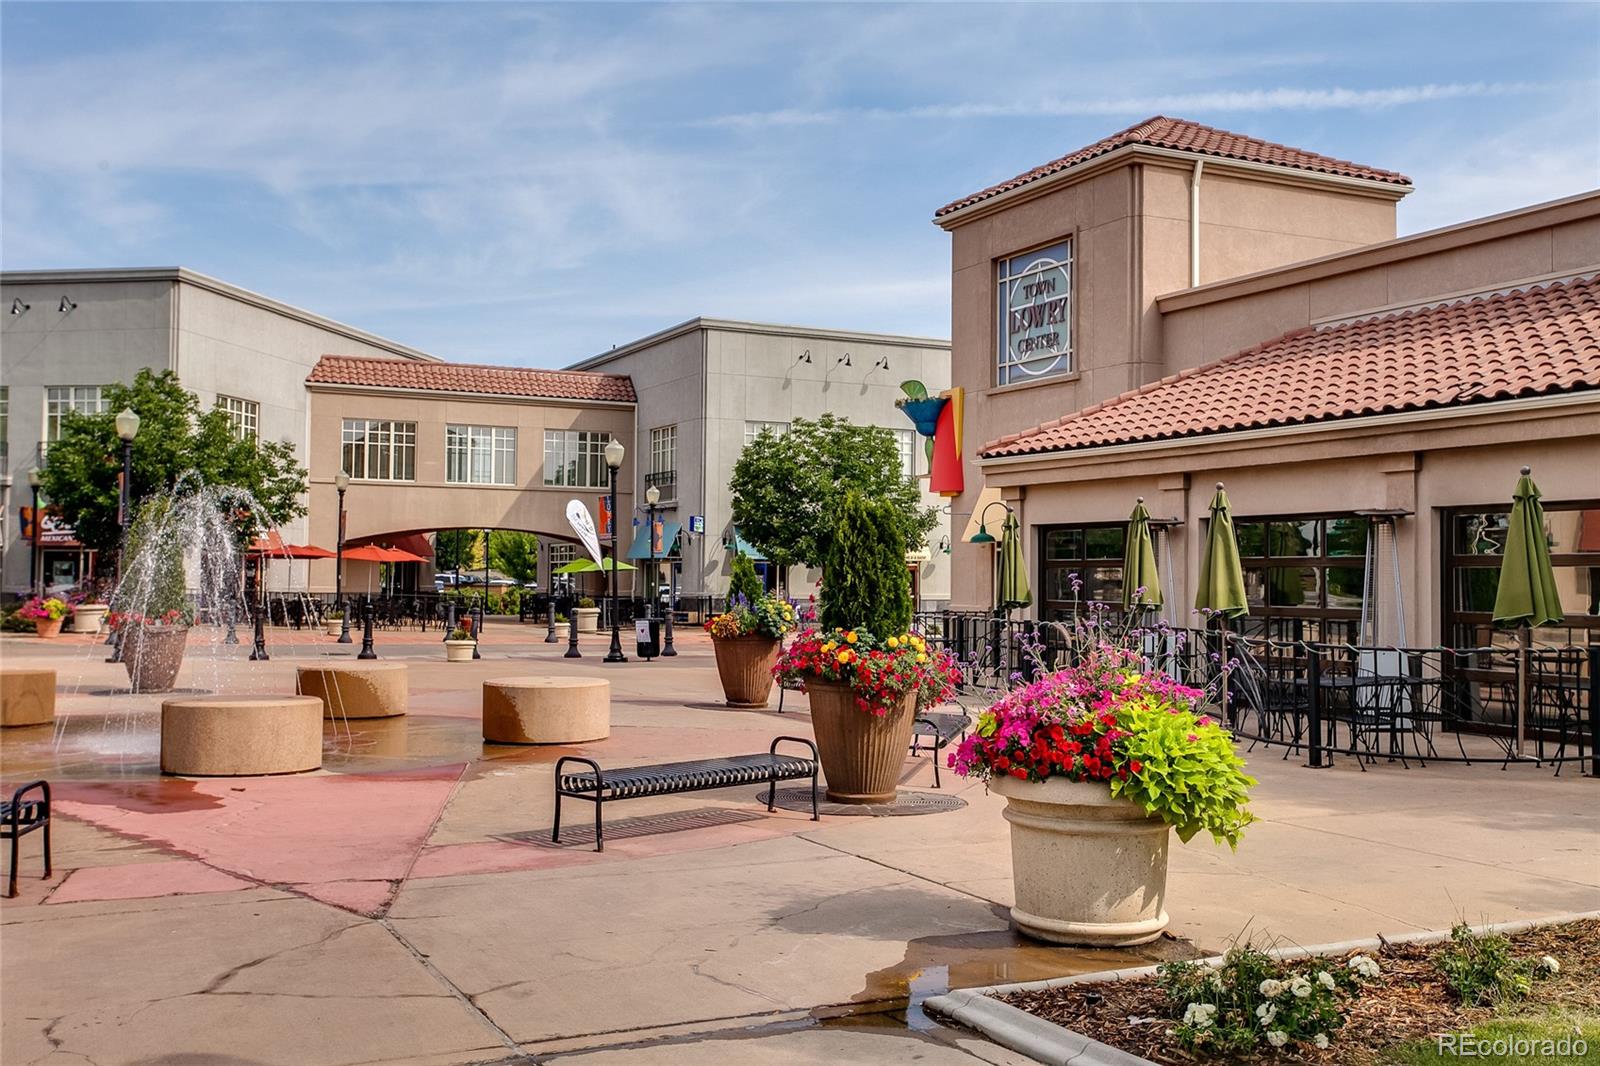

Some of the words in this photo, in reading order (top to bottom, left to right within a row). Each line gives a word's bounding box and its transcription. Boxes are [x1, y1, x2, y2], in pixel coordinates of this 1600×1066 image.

[1023, 277, 1056, 300] TOWN
[1010, 297, 1068, 334] LOWRY
[1018, 333, 1060, 354] CENTER
